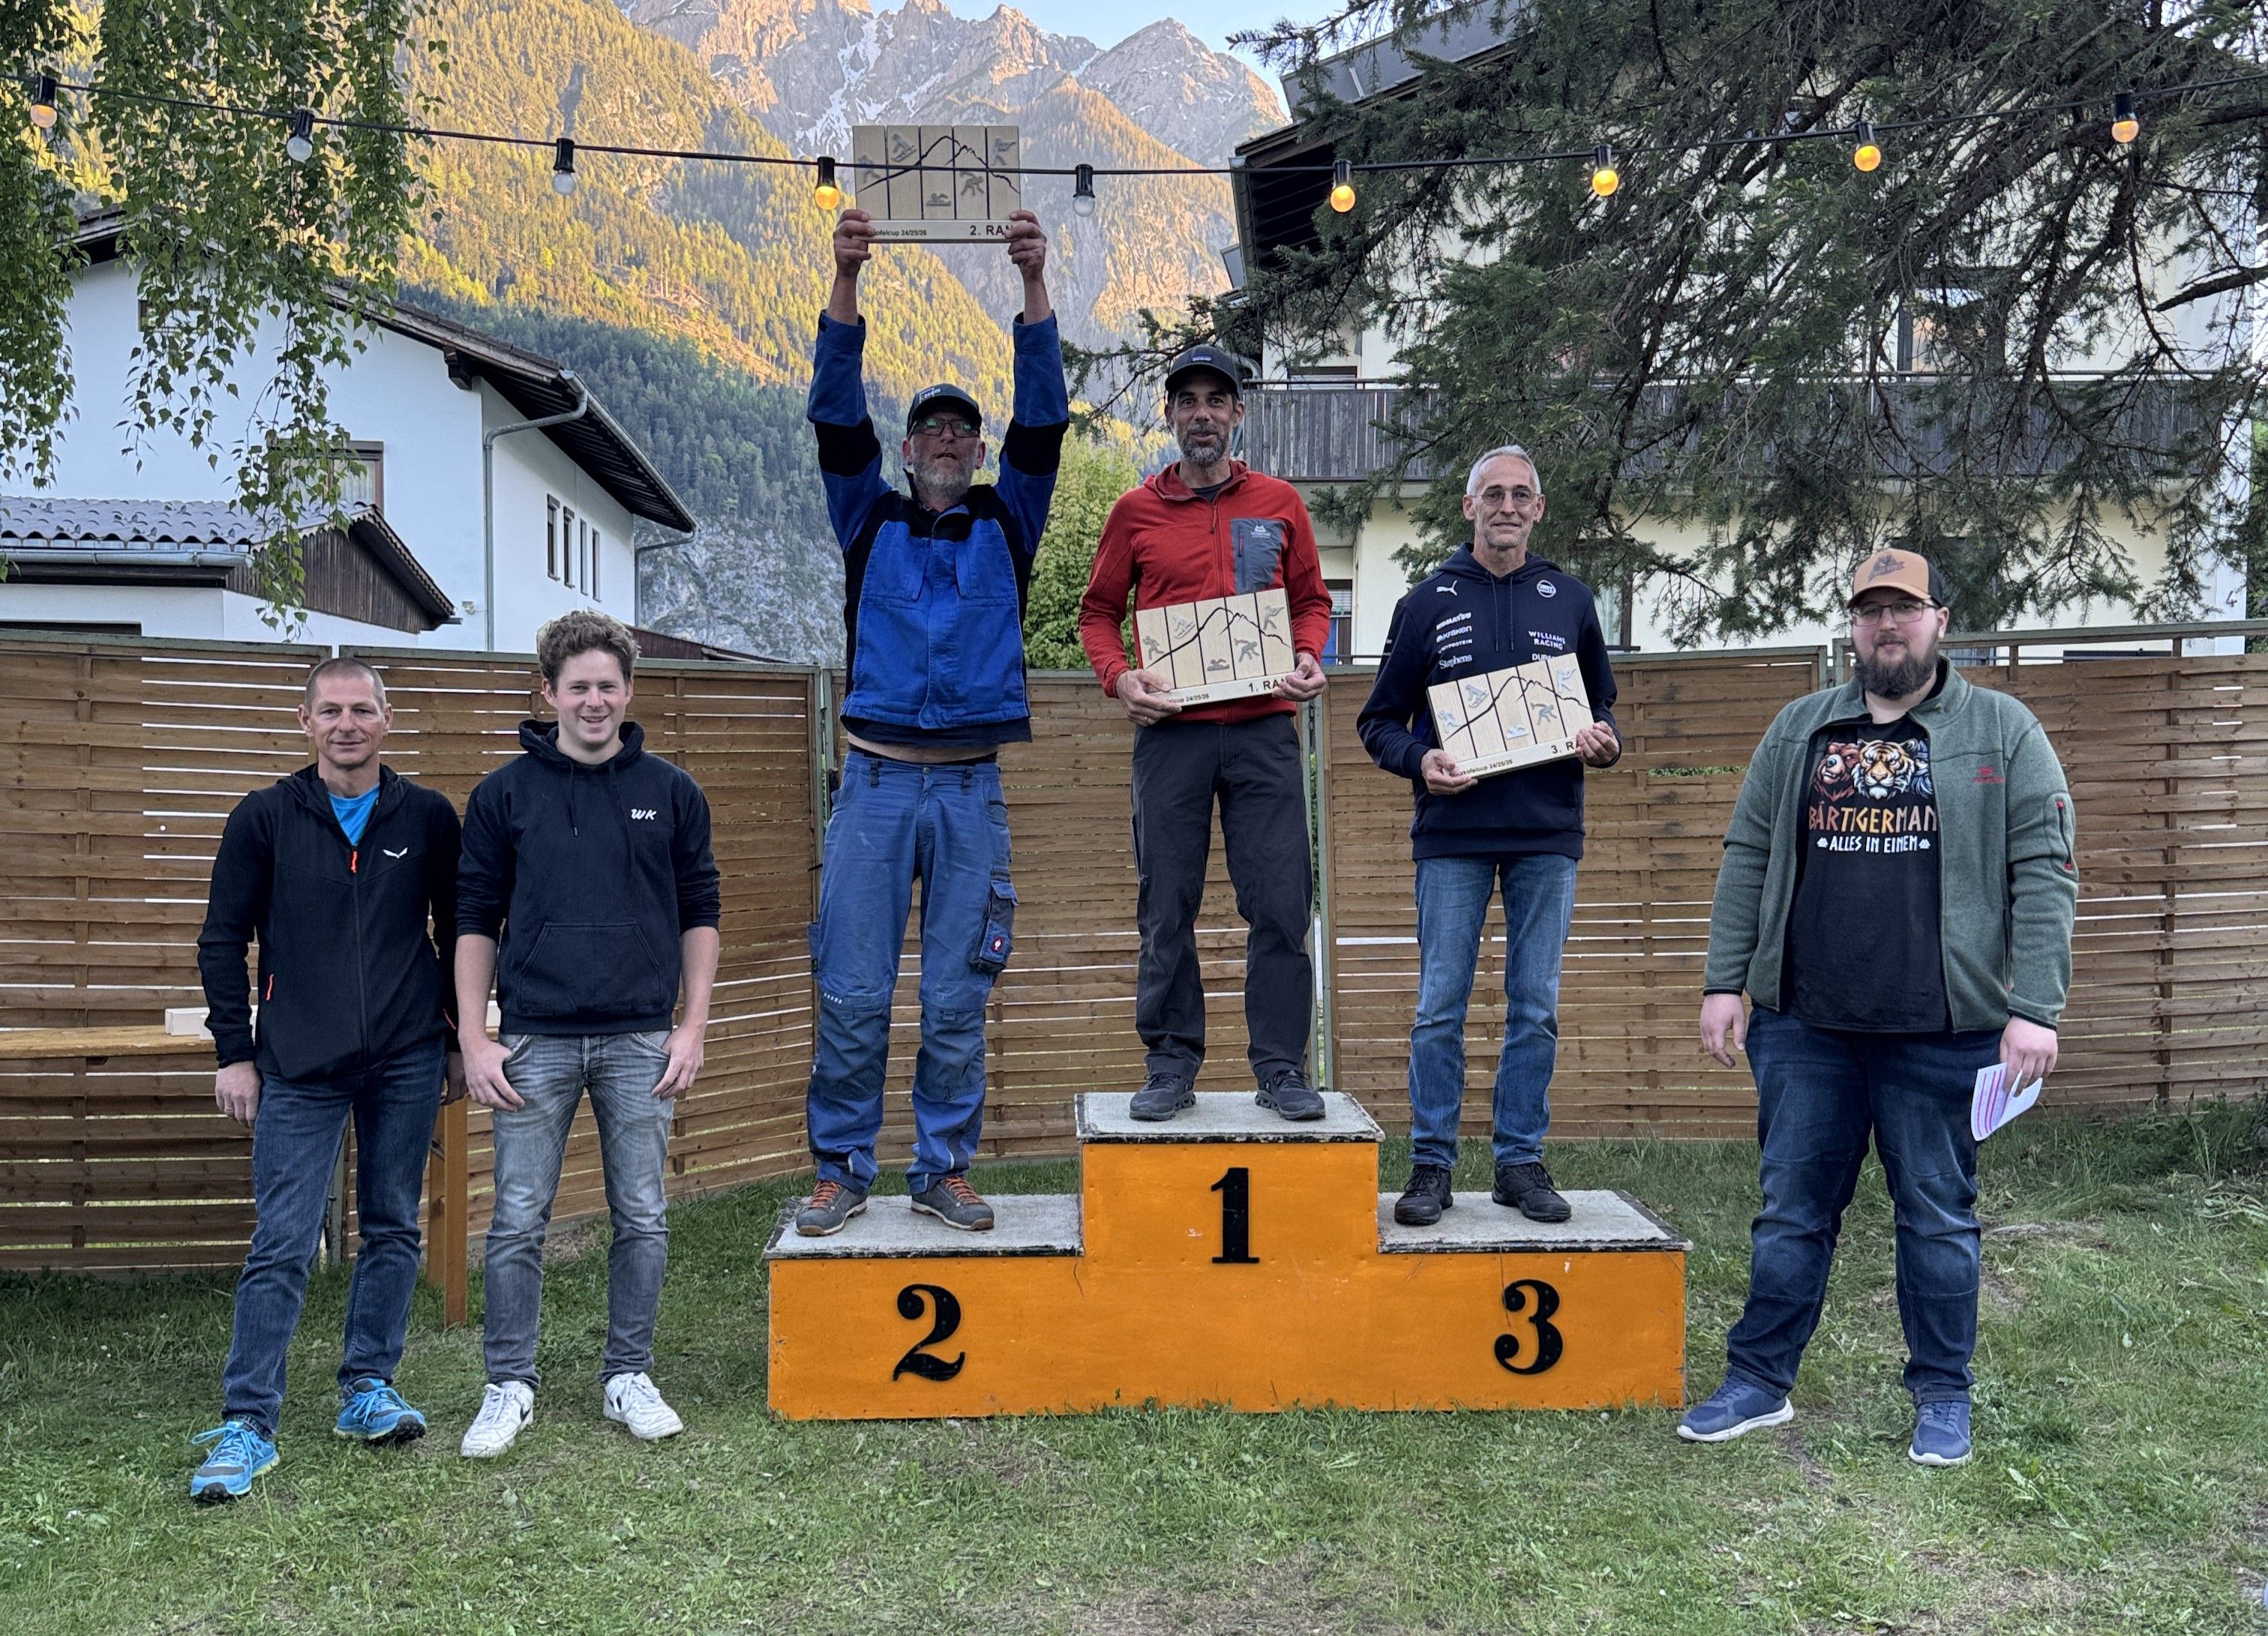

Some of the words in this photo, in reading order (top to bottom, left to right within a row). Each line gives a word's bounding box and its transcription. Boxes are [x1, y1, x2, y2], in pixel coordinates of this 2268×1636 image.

[970, 225, 981, 236] 2.
[2226, 590, 2237, 607] 4
[1528, 631, 1566, 645] WILLIAMS
[1534, 638, 1563, 651] RACING
[1438, 655, 1473, 670] Stephens
[1248, 682, 1258, 693] 1.
[1551, 745, 1562, 754] 3.
[1828, 835, 1862, 852] ALLES
[1865, 836, 1880, 853] IN
[1883, 834, 1918, 853] EINEM
[1210, 1167, 1260, 1263] 1
[892, 1284, 965, 1381] 2
[1494, 1279, 1563, 1374] 3
